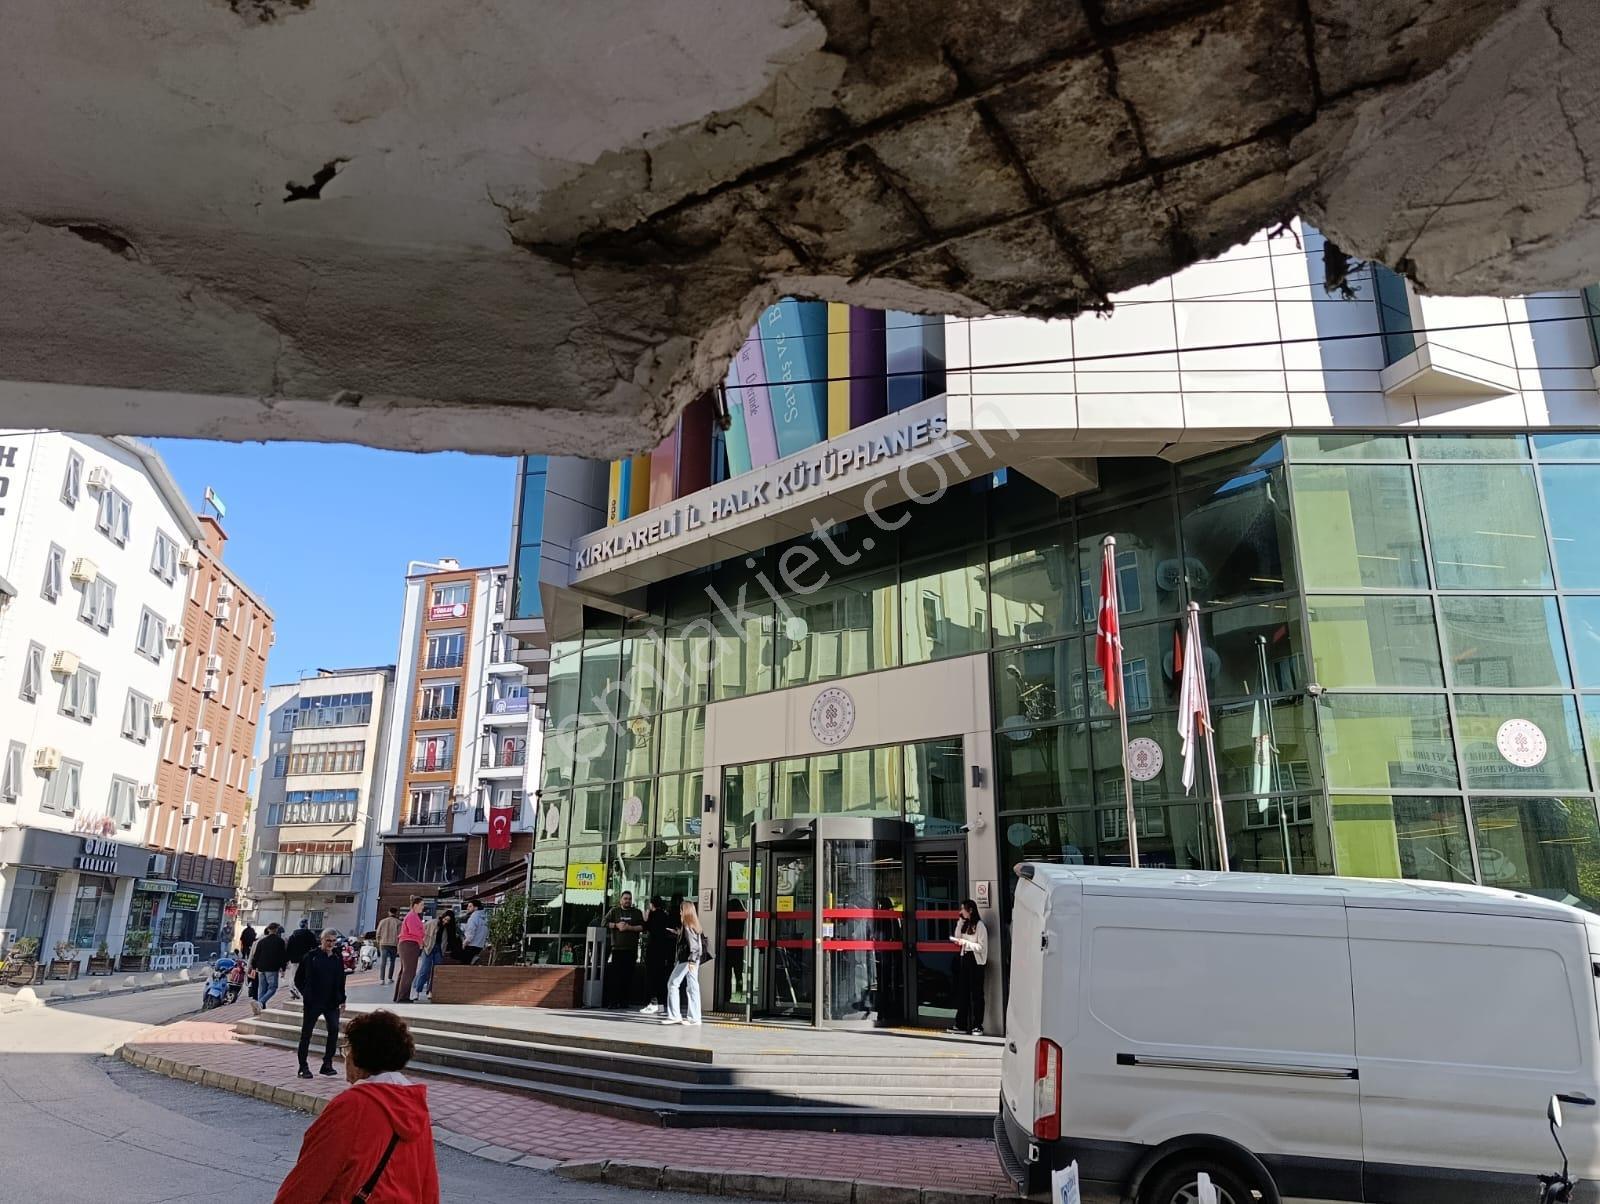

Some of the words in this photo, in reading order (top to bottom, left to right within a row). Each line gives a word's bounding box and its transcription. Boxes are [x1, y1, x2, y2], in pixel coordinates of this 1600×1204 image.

[776, 332, 787, 358] ve
[575, 511, 677, 570] KIRKLARELİ
[686, 504, 702, 531] İL
[710, 483, 766, 522] HALK
[775, 415, 947, 499] KÜTÜPHANES
[93, 840, 118, 858] HOTEL
